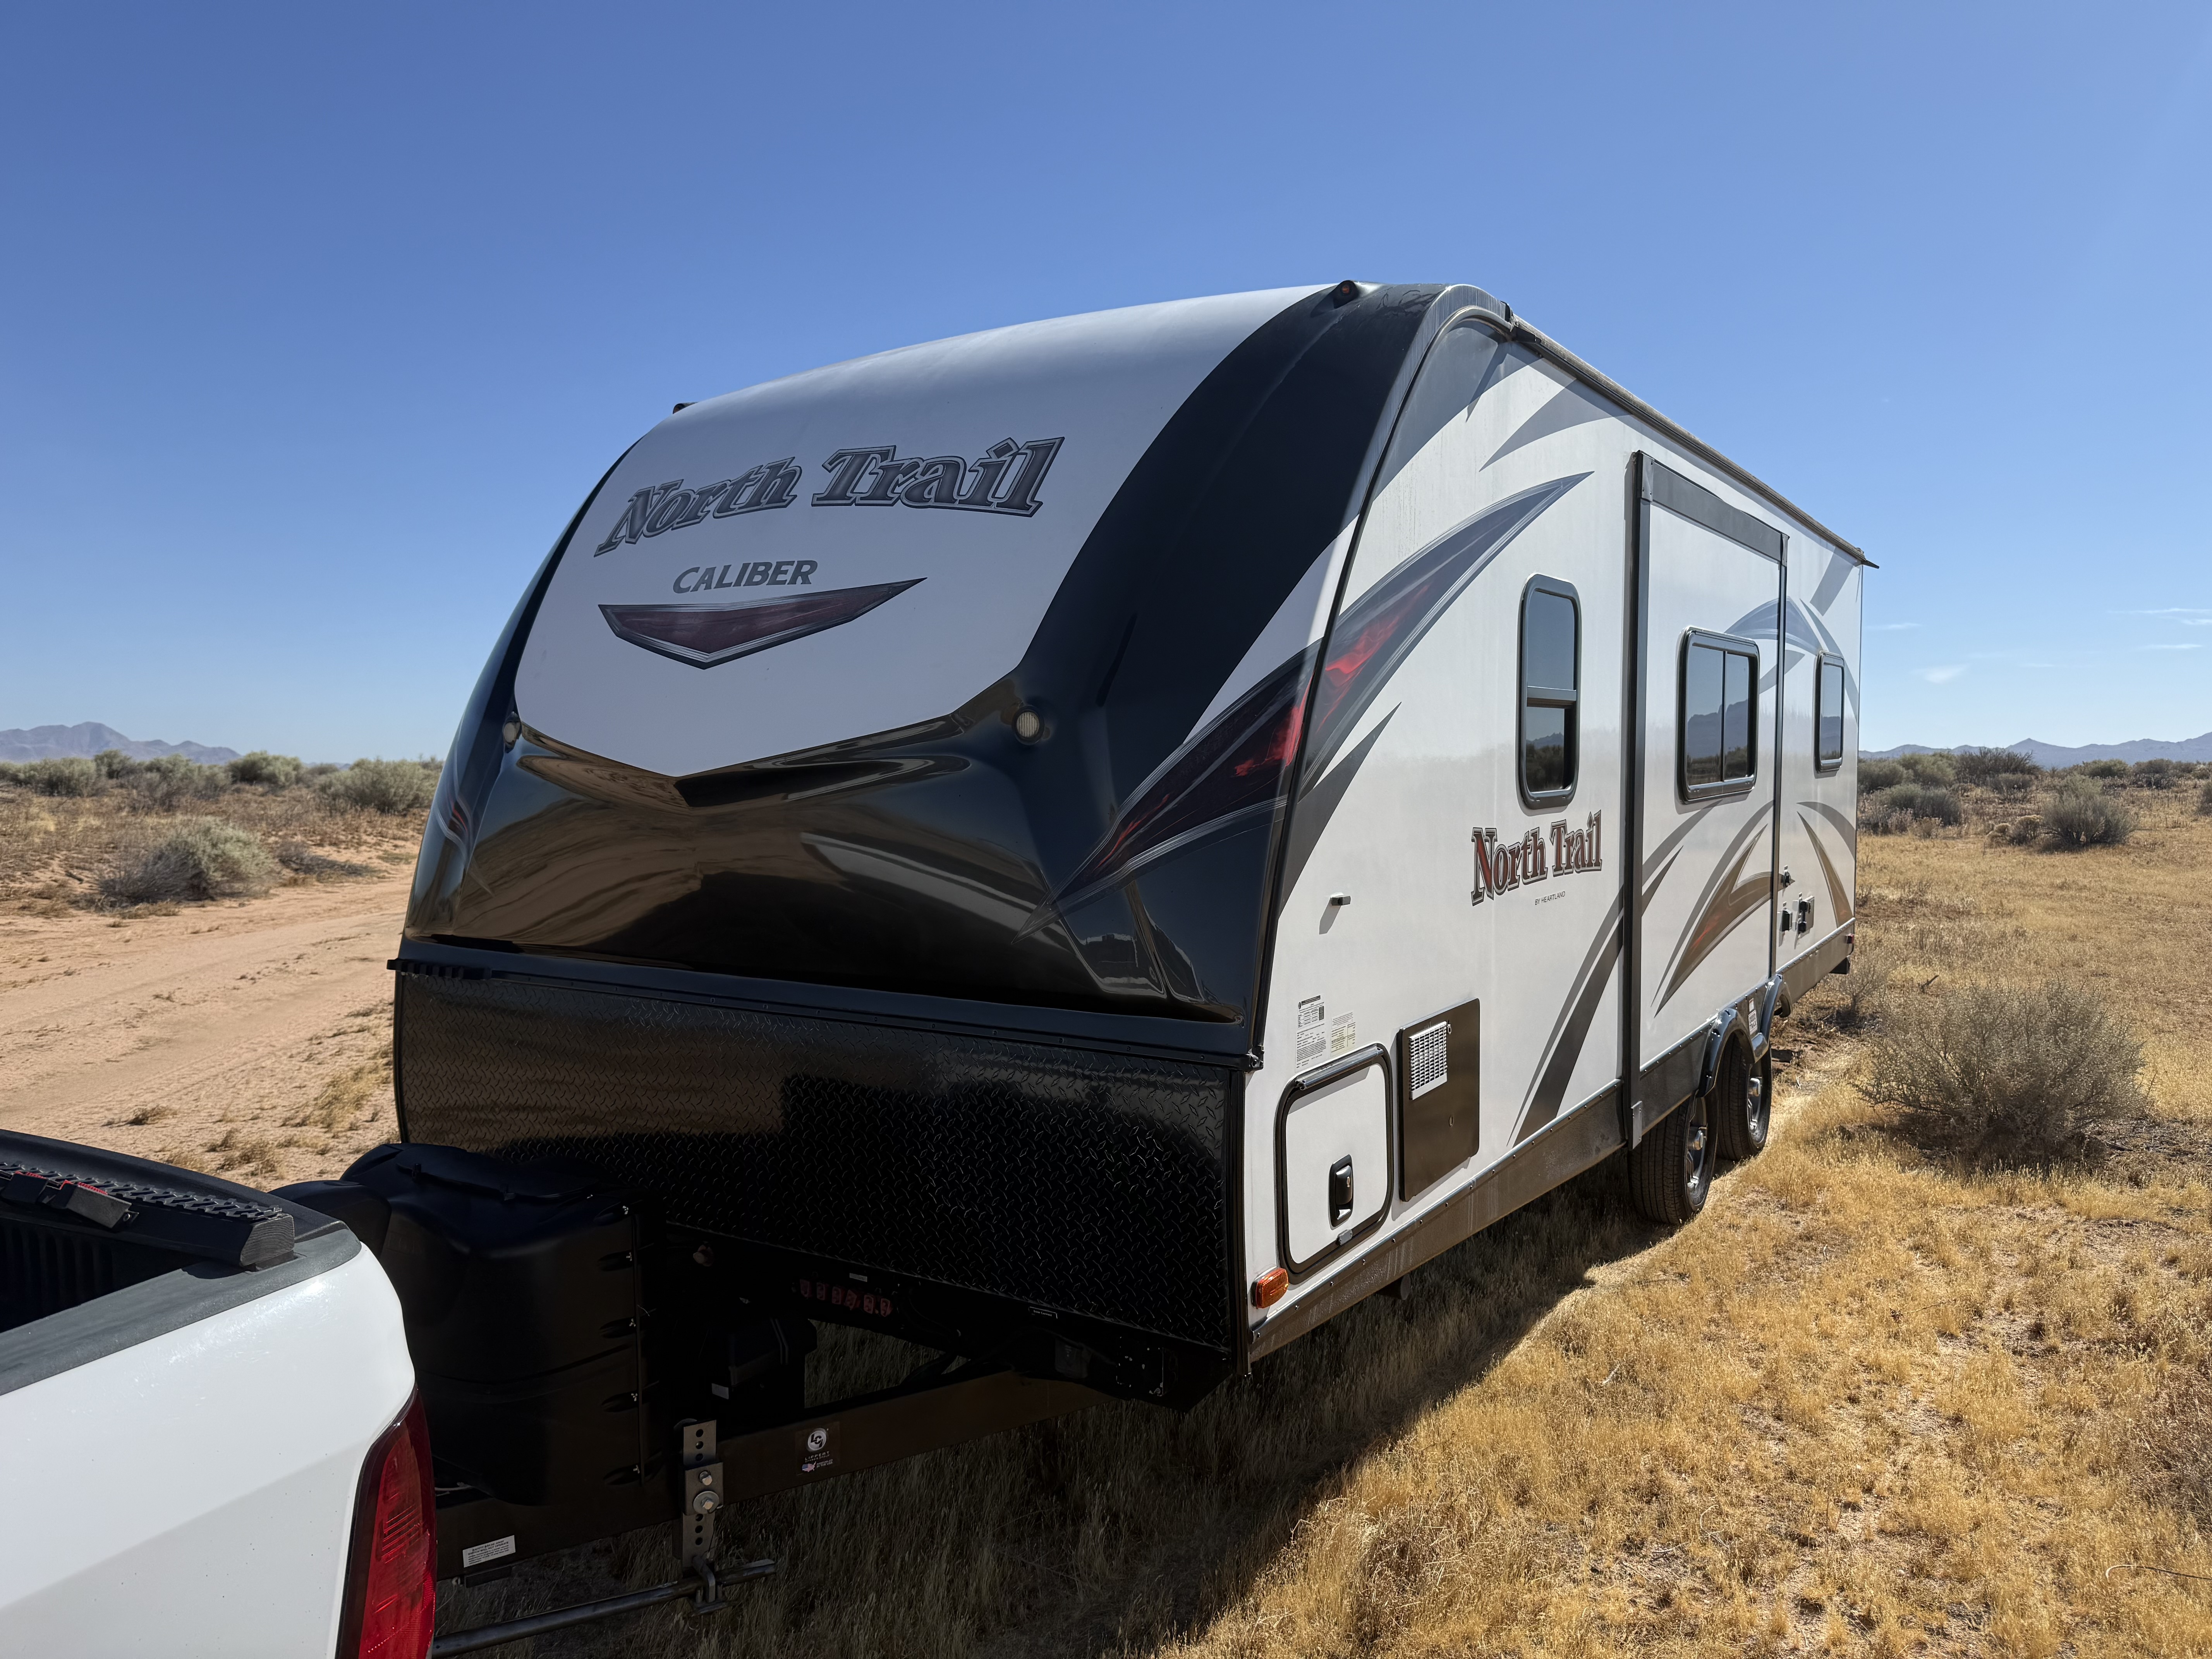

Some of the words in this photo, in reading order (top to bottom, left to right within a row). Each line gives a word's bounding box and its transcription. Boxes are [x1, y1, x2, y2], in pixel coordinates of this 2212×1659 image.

[594, 456, 802, 557] North
[811, 436, 1065, 517] Trail
[673, 560, 818, 594] CALIBER
[1471, 827, 1548, 906] North
[1549, 809, 1602, 877] Trail
[1542, 891, 1565, 903] HEARTLAND
[805, 1451, 830, 1460] LIPPERT
